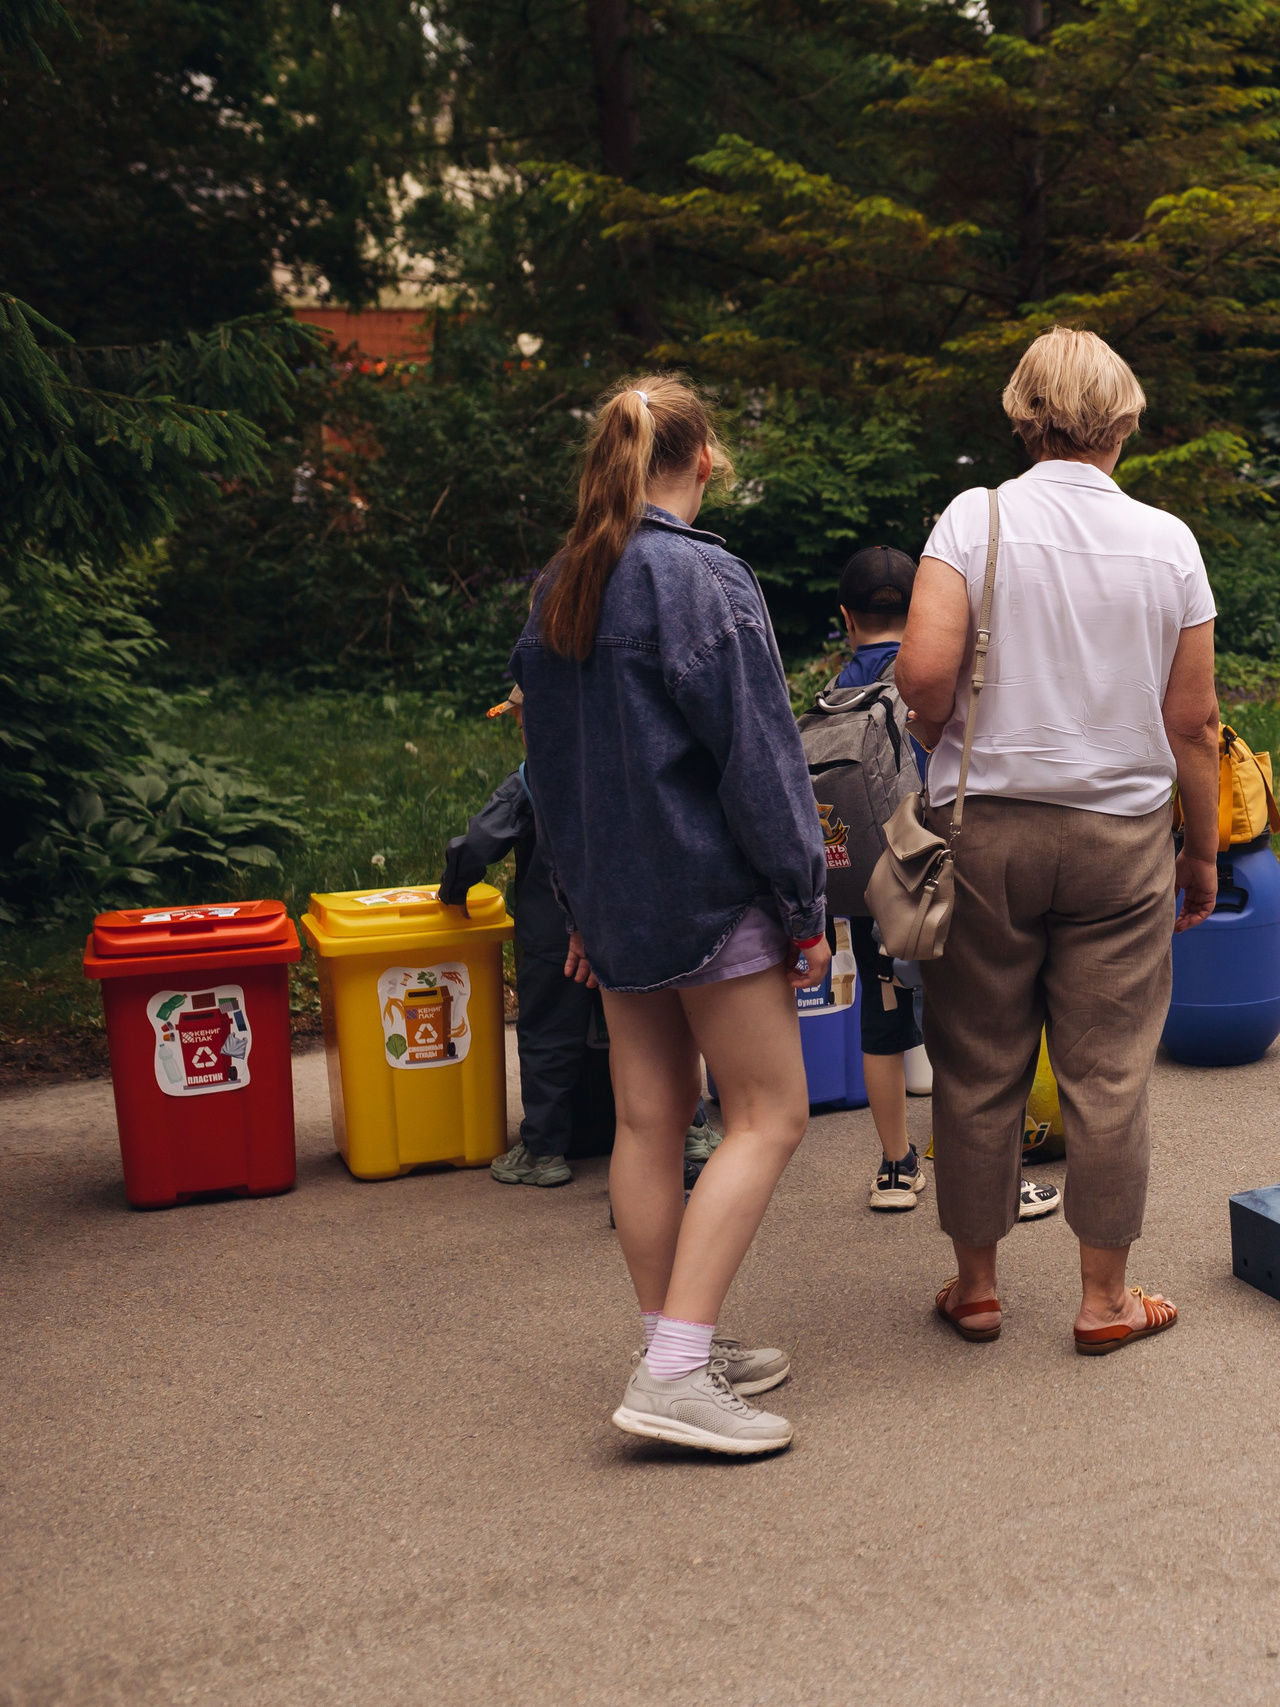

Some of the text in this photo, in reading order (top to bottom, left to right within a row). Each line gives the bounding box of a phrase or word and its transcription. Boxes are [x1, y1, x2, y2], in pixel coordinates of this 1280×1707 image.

[194, 1027, 221, 1036] КЕНИГ
[194, 1035, 213, 1043] ПАК
[187, 1072, 224, 1086] ПЛАСТИК
